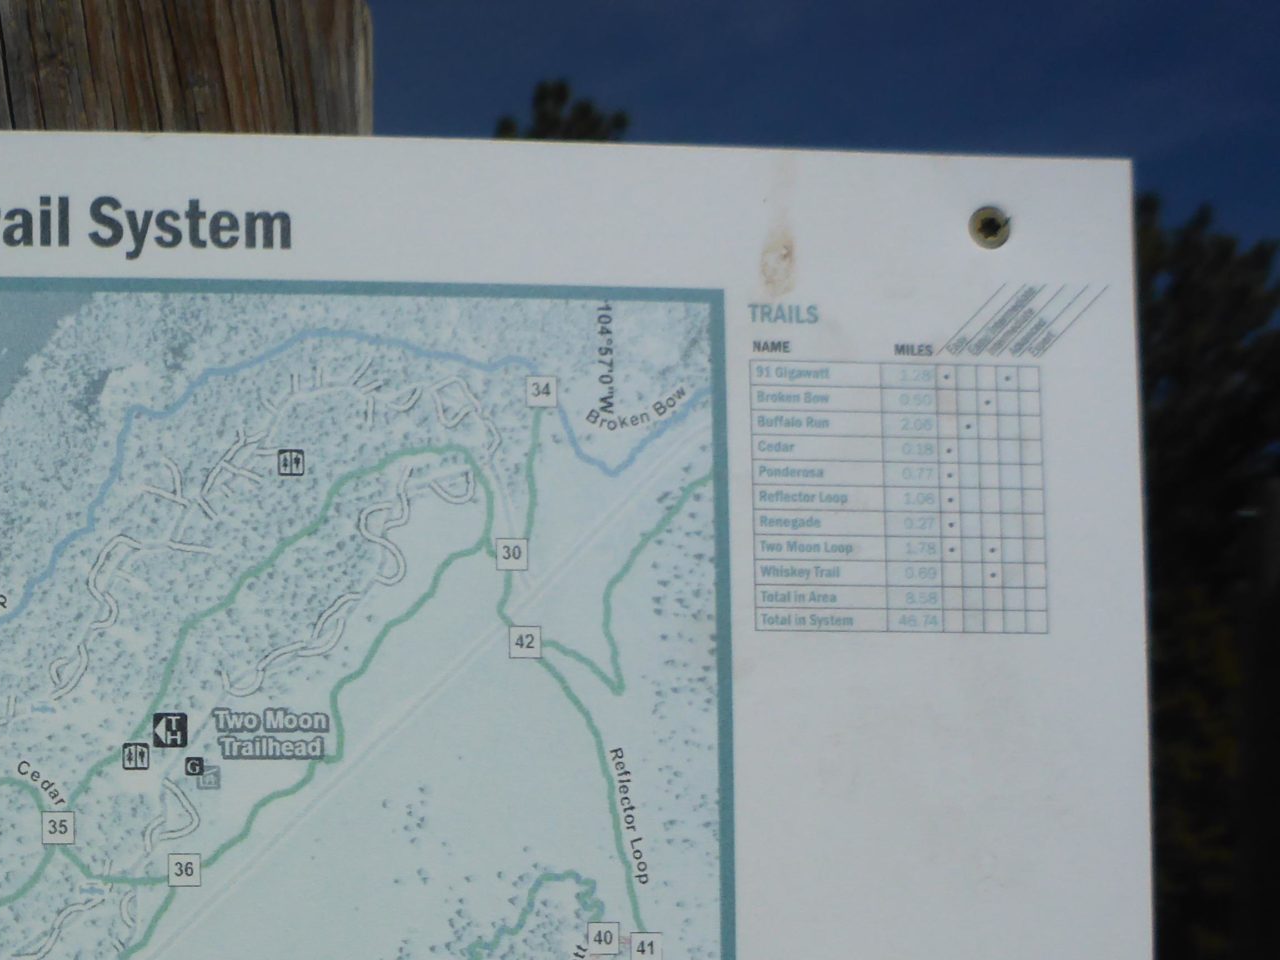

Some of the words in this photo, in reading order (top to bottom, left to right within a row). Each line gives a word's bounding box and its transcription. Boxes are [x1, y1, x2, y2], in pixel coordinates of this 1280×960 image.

[88, 196, 292, 260] System
[748, 304, 819, 324] TRAILS
[752, 341, 791, 353] NAME
[894, 343, 933, 356] MILES
[756, 367, 772, 378] 91
[775, 367, 830, 381] Gigawatt
[531, 383, 551, 398] 34
[757, 391, 800, 403] Broken
[803, 393, 830, 404] Bow
[586, 408, 651, 431] Broken
[652, 386, 688, 418] Bow
[757, 416, 803, 429] Buffalo
[806, 417, 830, 429] Run
[758, 441, 795, 453] Cedar
[758, 466, 824, 478] Ponderosa
[759, 491, 816, 503] Reflector
[819, 491, 848, 505] Loop
[759, 516, 821, 530] Renegade
[502, 546, 522, 561] 30
[760, 541, 783, 553] Two
[786, 541, 821, 553] Moon
[824, 542, 853, 556] Loop
[760, 565, 811, 579] Whiskey
[813, 566, 840, 578] Trail
[761, 591, 791, 603] Total
[795, 591, 805, 603] in
[809, 591, 837, 603] Area
[761, 614, 792, 626] Total
[795, 614, 806, 626] in
[809, 614, 854, 628] System
[515, 634, 535, 649] 42
[213, 709, 258, 732] Two
[264, 709, 329, 732] Moon
[221, 736, 324, 759] Trailhead
[17, 759, 65, 807] Cedar
[609, 747, 636, 832] Reflector
[630, 836, 650, 885] Loop
[48, 819, 68, 835] 35
[174, 862, 194, 877] 36
[594, 930, 613, 945] 40
[636, 941, 654, 955] 41
